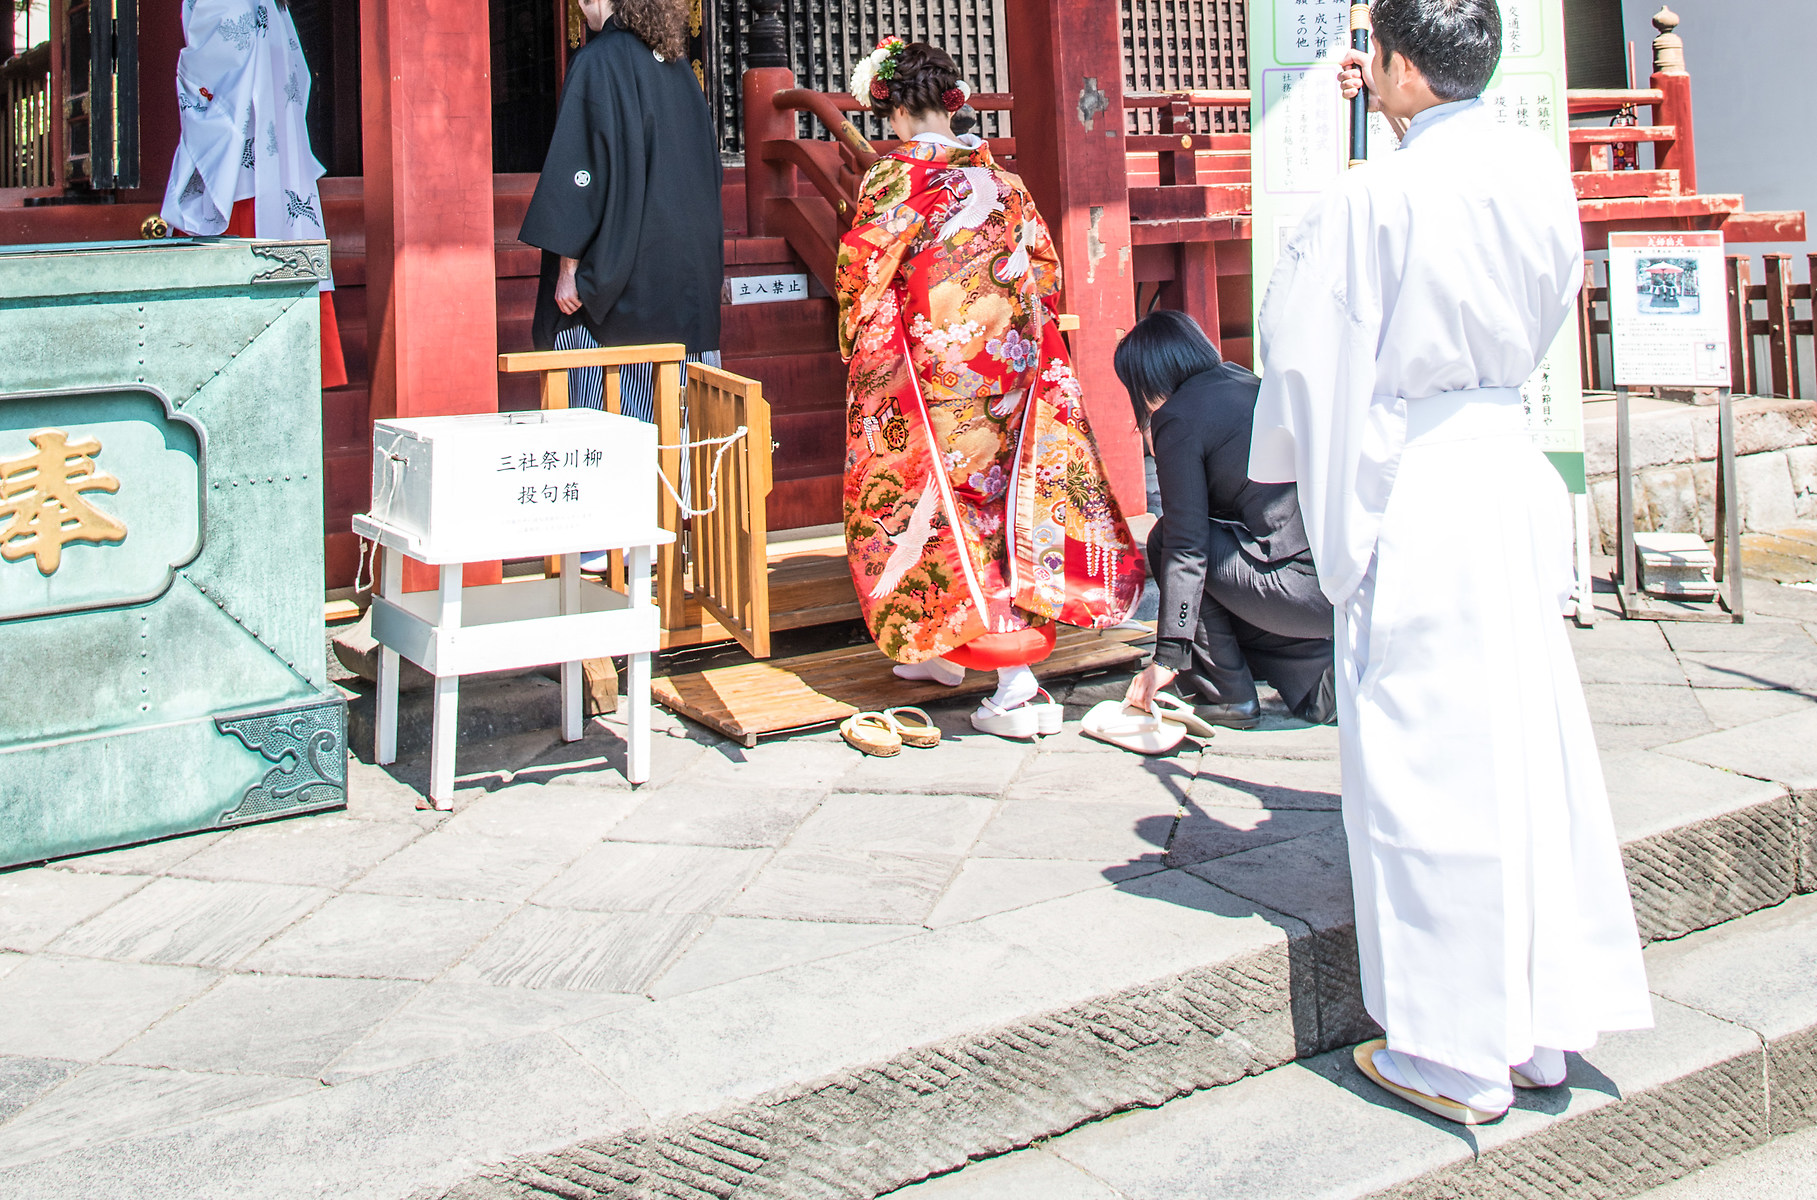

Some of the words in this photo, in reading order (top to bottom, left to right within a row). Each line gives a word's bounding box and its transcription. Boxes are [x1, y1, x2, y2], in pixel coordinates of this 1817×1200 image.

[1296, 15, 1309, 48] その他
[1315, 13, 1327, 59] 成人祈願
[1509, 6, 1521, 53] 交通安全
[1495, 96, 1508, 123] 竣工
[1537, 95, 1550, 131] 地鎮祭
[739, 280, 801, 296] 立入禁止
[1540, 356, 1552, 427] 心身の節目や
[496, 448, 603, 472] 三社祭川柳
[517, 482, 579, 505] 投句箱
